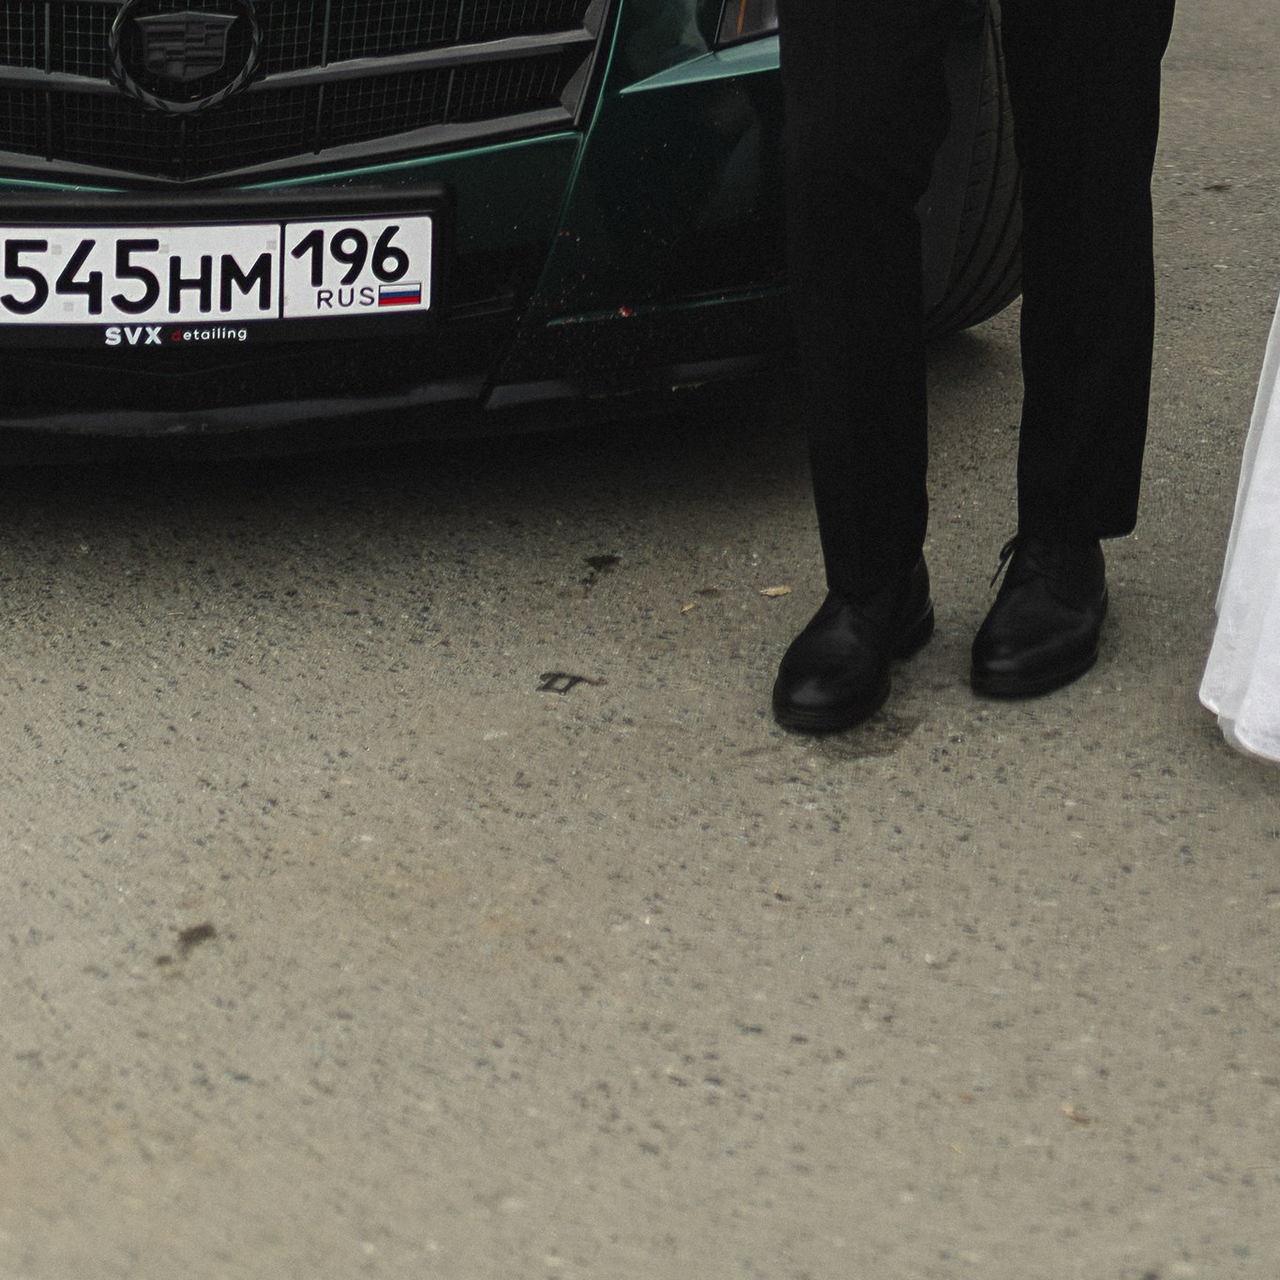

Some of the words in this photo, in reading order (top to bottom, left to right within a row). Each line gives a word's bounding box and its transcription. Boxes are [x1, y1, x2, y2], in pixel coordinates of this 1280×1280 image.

[291, 225, 410, 287] 196
[317, 286, 375, 309] RUS
[104, 326, 162, 345] SVX
